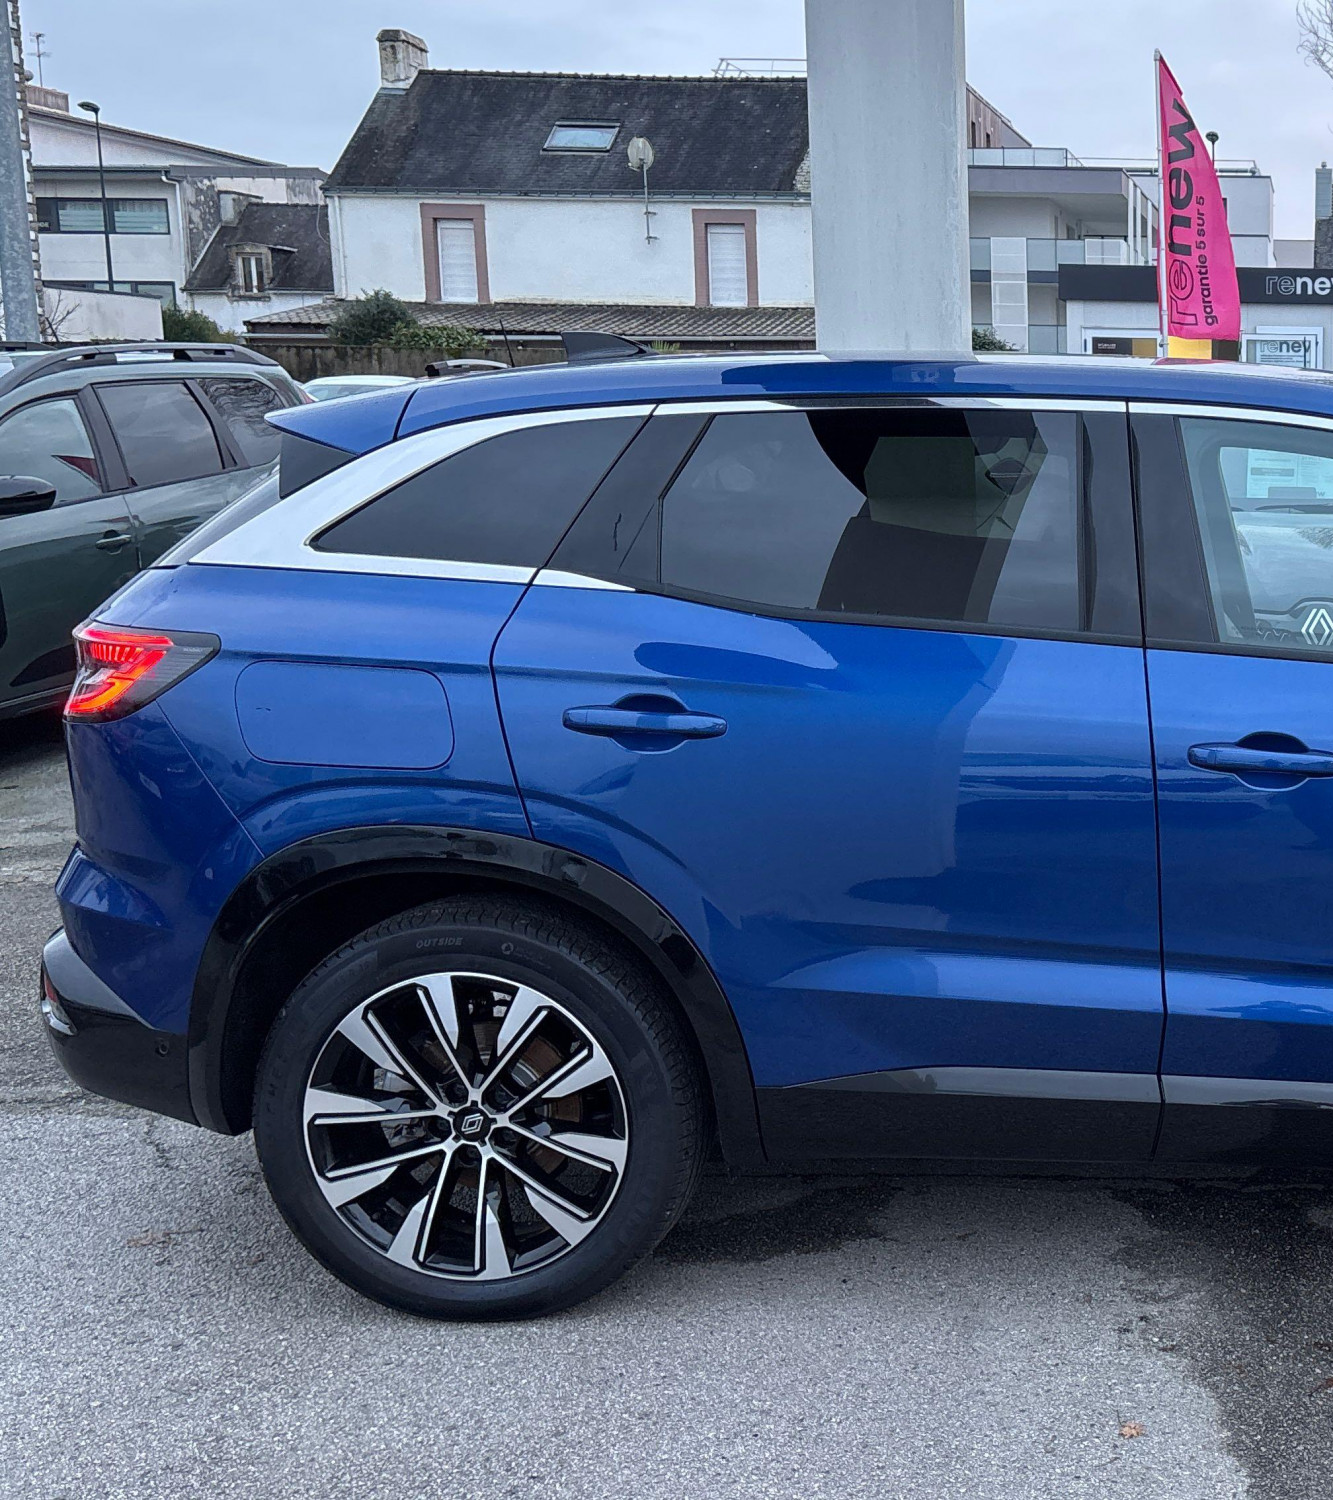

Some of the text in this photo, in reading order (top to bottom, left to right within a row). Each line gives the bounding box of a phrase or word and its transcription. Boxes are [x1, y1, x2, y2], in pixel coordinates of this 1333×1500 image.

[1167, 98, 1198, 327] renew
[1196, 195, 1218, 327] garantie 5 sur 5
[416, 937, 464, 949] OUTSIDE
